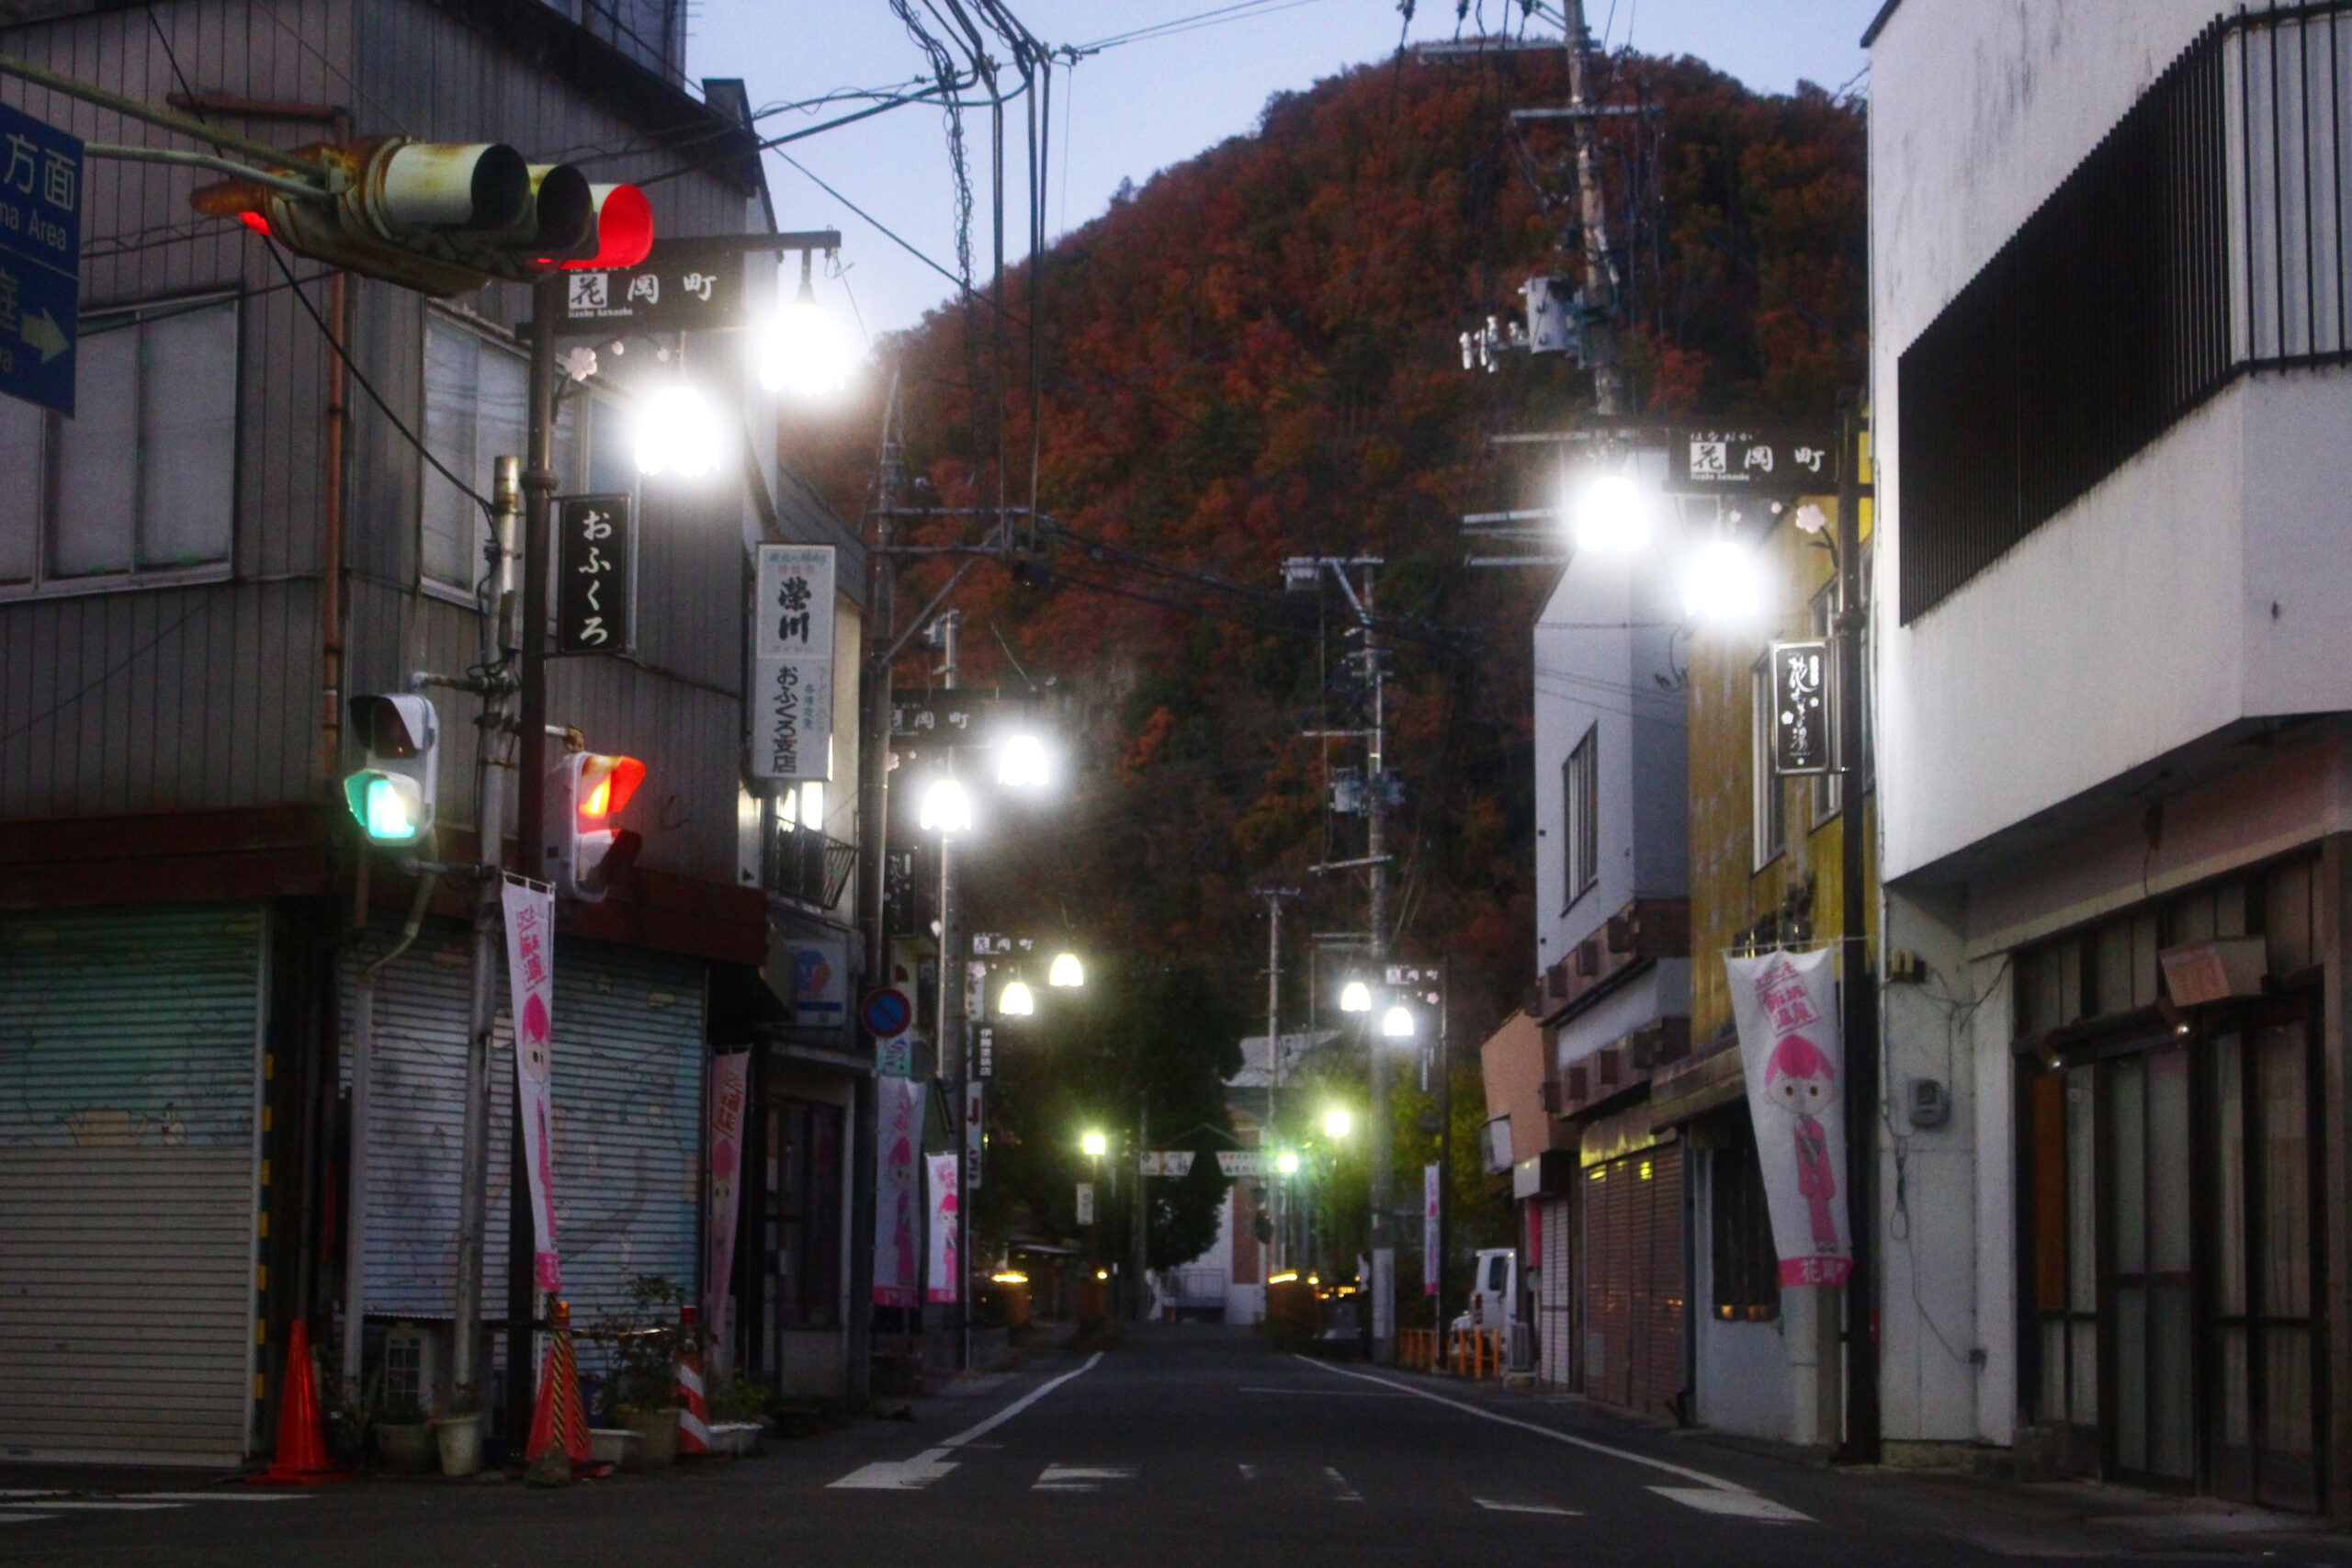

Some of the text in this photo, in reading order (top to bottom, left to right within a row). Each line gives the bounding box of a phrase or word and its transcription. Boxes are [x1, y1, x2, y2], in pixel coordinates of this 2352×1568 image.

[4, 132, 76, 212] 方面
[28, 208, 67, 251] Area
[579, 510, 612, 645] おふくろ
